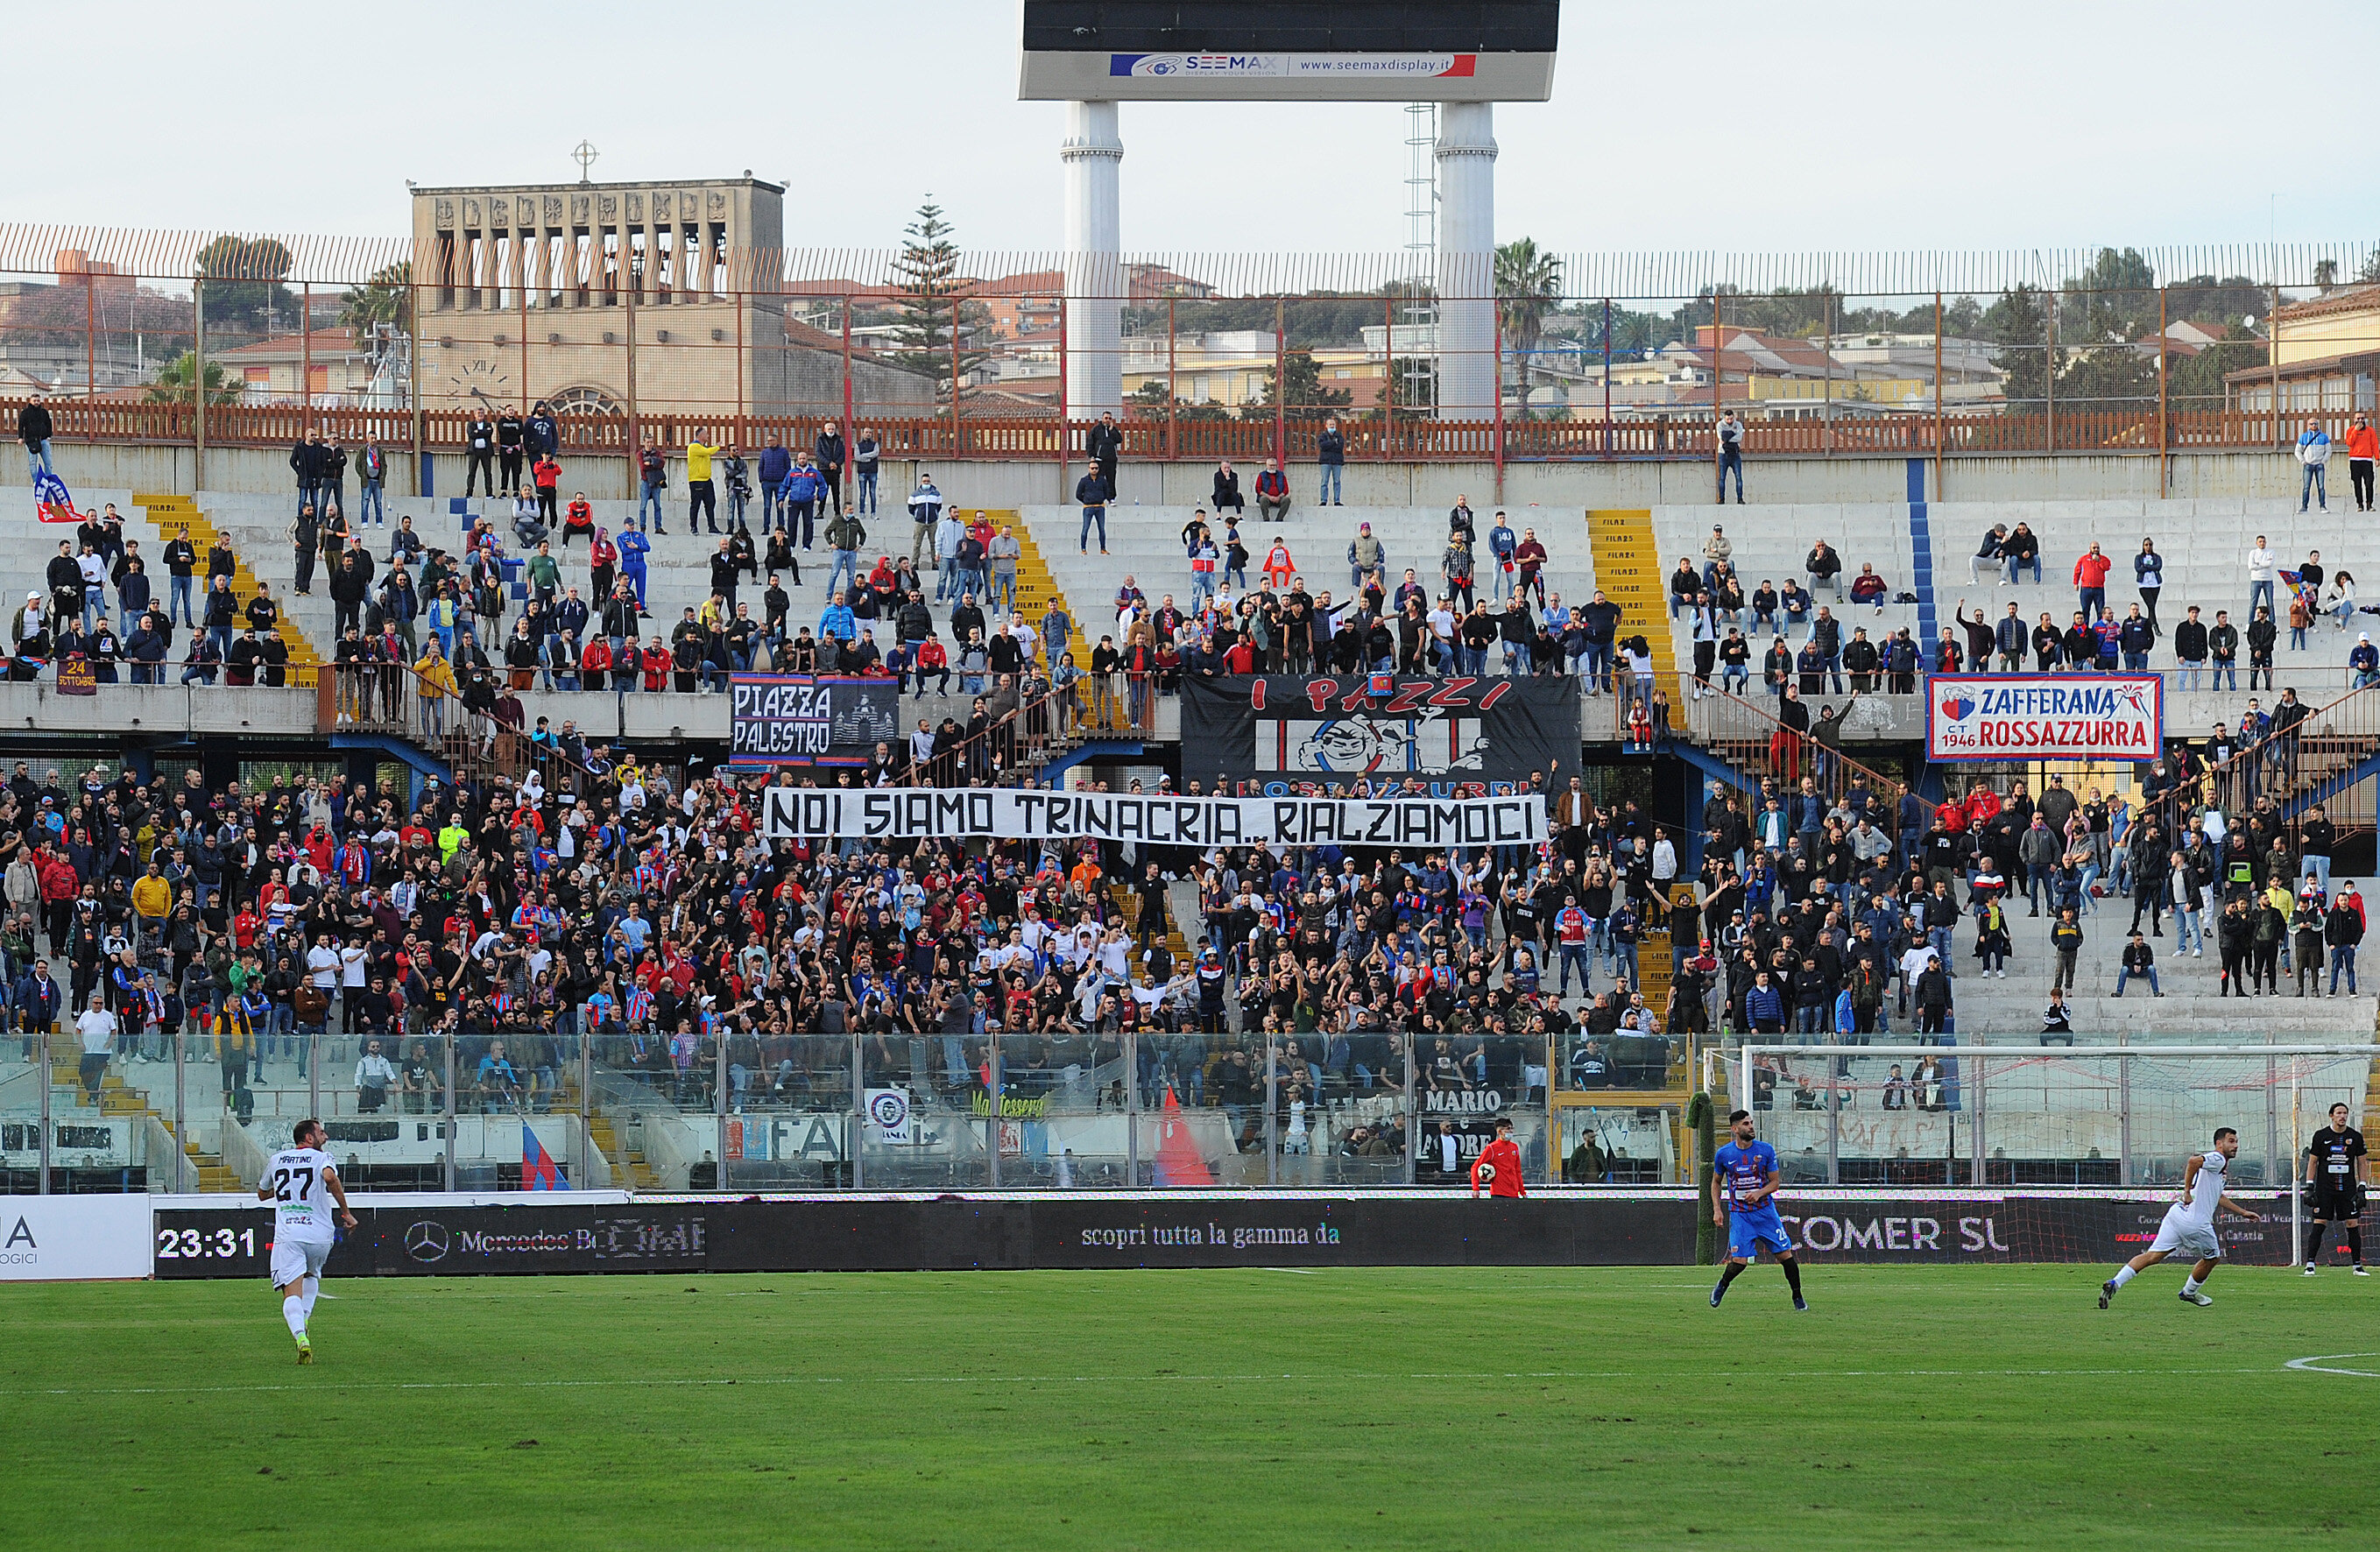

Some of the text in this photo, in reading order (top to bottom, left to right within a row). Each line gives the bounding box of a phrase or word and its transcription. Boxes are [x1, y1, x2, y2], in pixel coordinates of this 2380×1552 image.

[1186, 56, 1276, 69] SEEMAX
[1301, 58, 1451, 73] www.seemaxdisplay.it
[67, 661, 86, 674] 24
[58, 675, 97, 687] SETTEMBRE
[734, 685, 830, 718] PIAZZA
[1251, 677, 1511, 712] I PAZZI
[1981, 688, 2115, 718] ZAFFERANA
[733, 721, 830, 754] PALESTRO
[1941, 735, 1975, 747] 1946
[1980, 721, 2147, 747] ROSSAZZURRA
[772, 793, 842, 835] NOI
[864, 793, 994, 836] SIAMO
[1274, 801, 1534, 844] RIALZIAMOCI
[1425, 1090, 1501, 1111] MARIO
[279, 1155, 312, 1164] MARTINO
[274, 1167, 314, 1203] 27
[158, 1228, 255, 1259] 23:31
[461, 1230, 569, 1252] Mercedes
[1081, 1222, 1340, 1250] scopri tutta la gamma da
